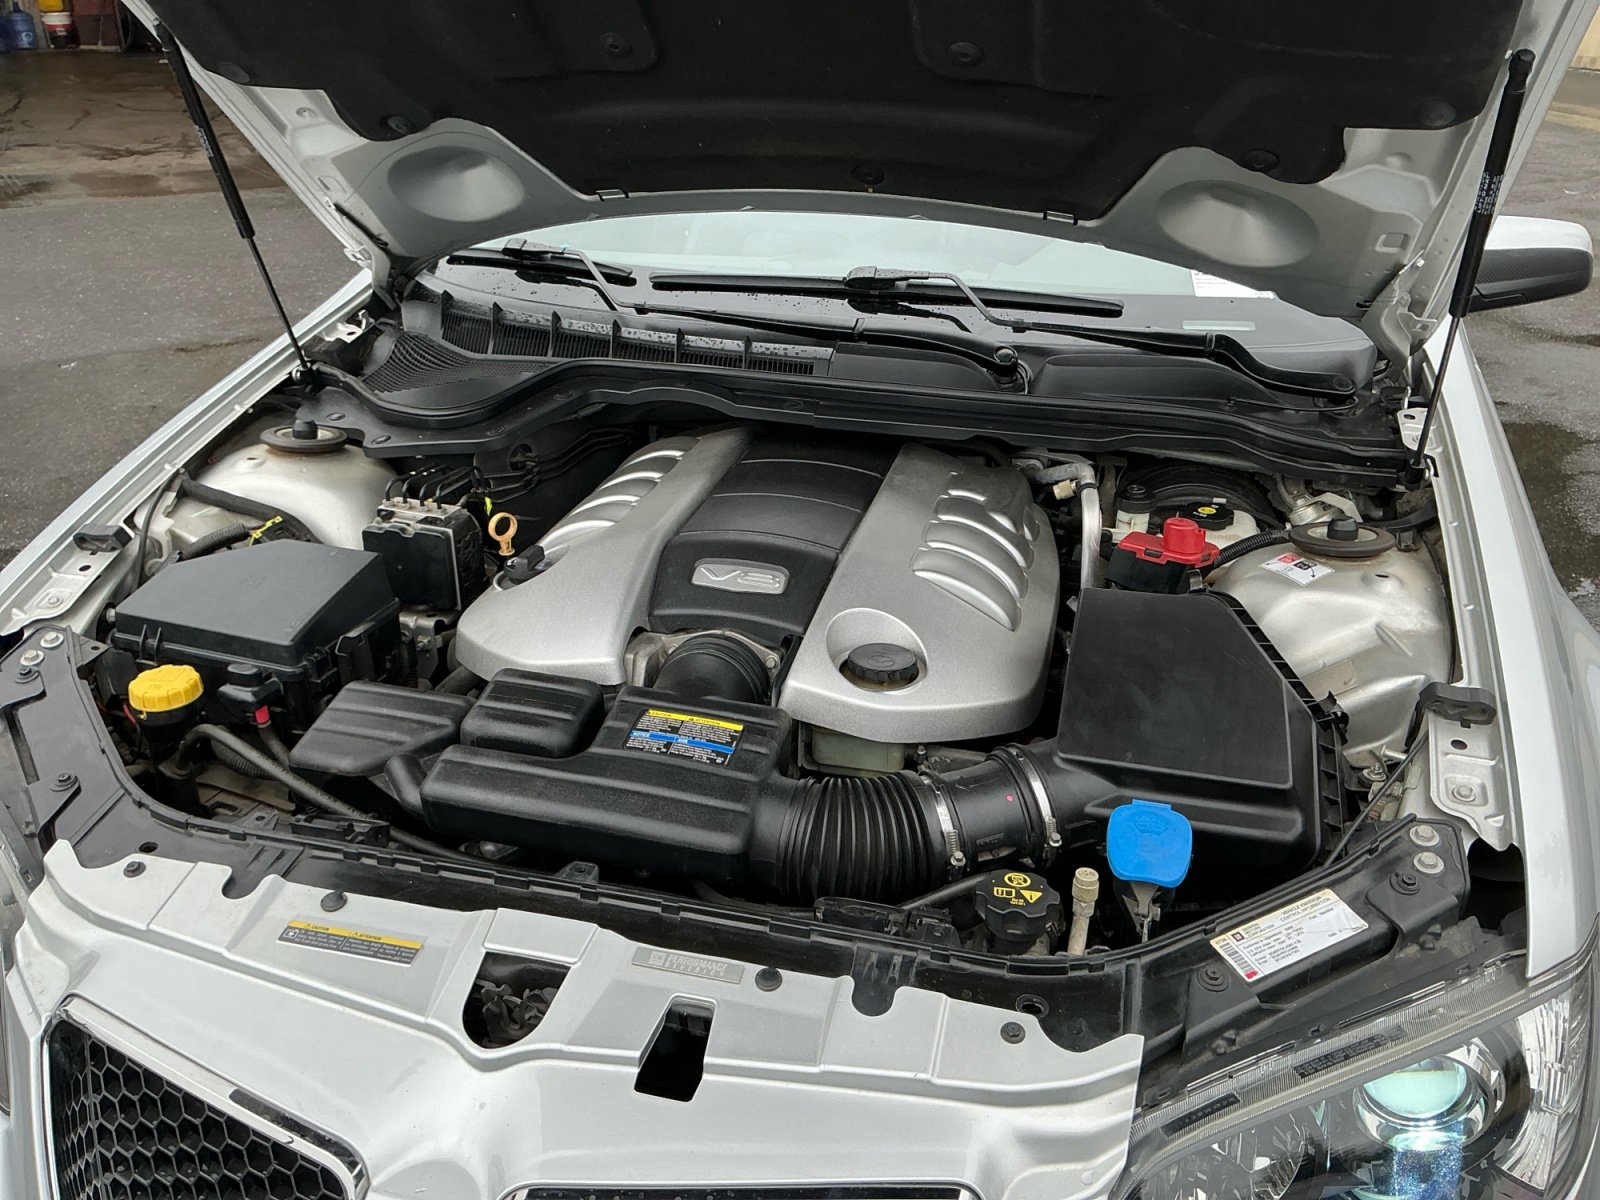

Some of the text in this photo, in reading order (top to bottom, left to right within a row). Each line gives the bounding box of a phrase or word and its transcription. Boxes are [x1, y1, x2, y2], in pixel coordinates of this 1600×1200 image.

[699, 567, 780, 589] V8
[664, 961, 725, 977] DIVISION
[667, 953, 728, 972] PERFORMANCE
